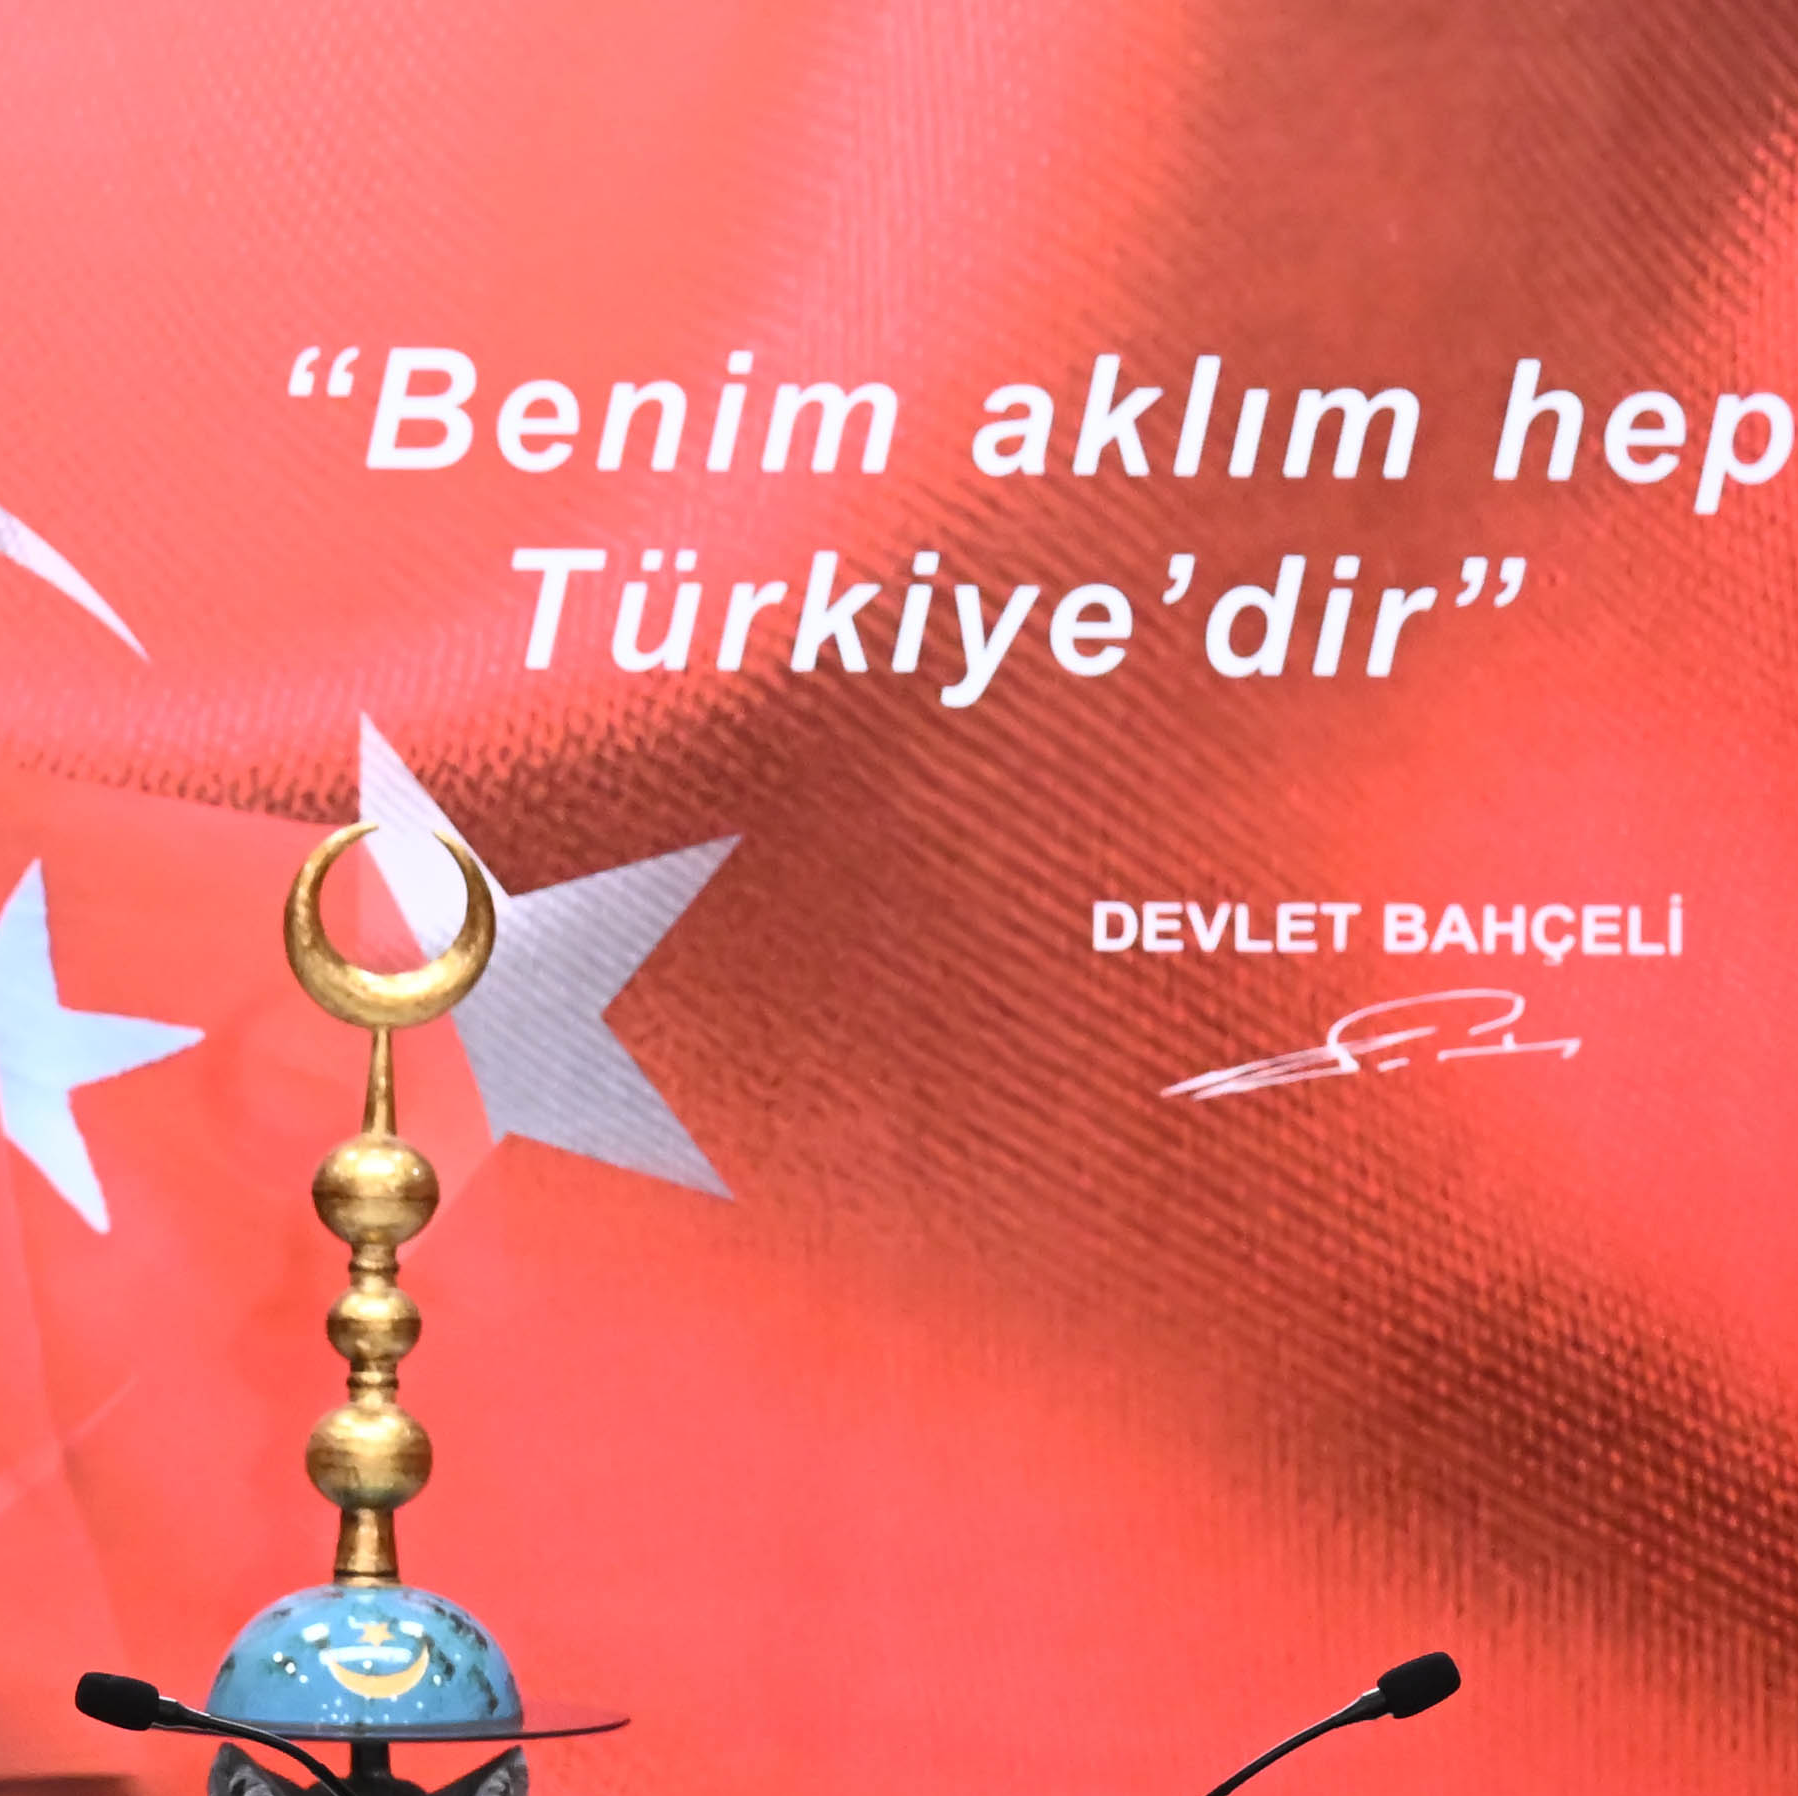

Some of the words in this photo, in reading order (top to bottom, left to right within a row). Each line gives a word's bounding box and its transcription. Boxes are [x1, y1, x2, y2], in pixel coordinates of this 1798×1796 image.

[288, 347, 898, 474] “Benim
[973, 355, 1420, 479] aklım
[1494, 359, 1794, 515] hep
[512, 549, 1525, 708] Türkiye’dir”
[1094, 902, 1361, 953] DEVLET
[1384, 895, 1683, 964] BAHÇELİ
